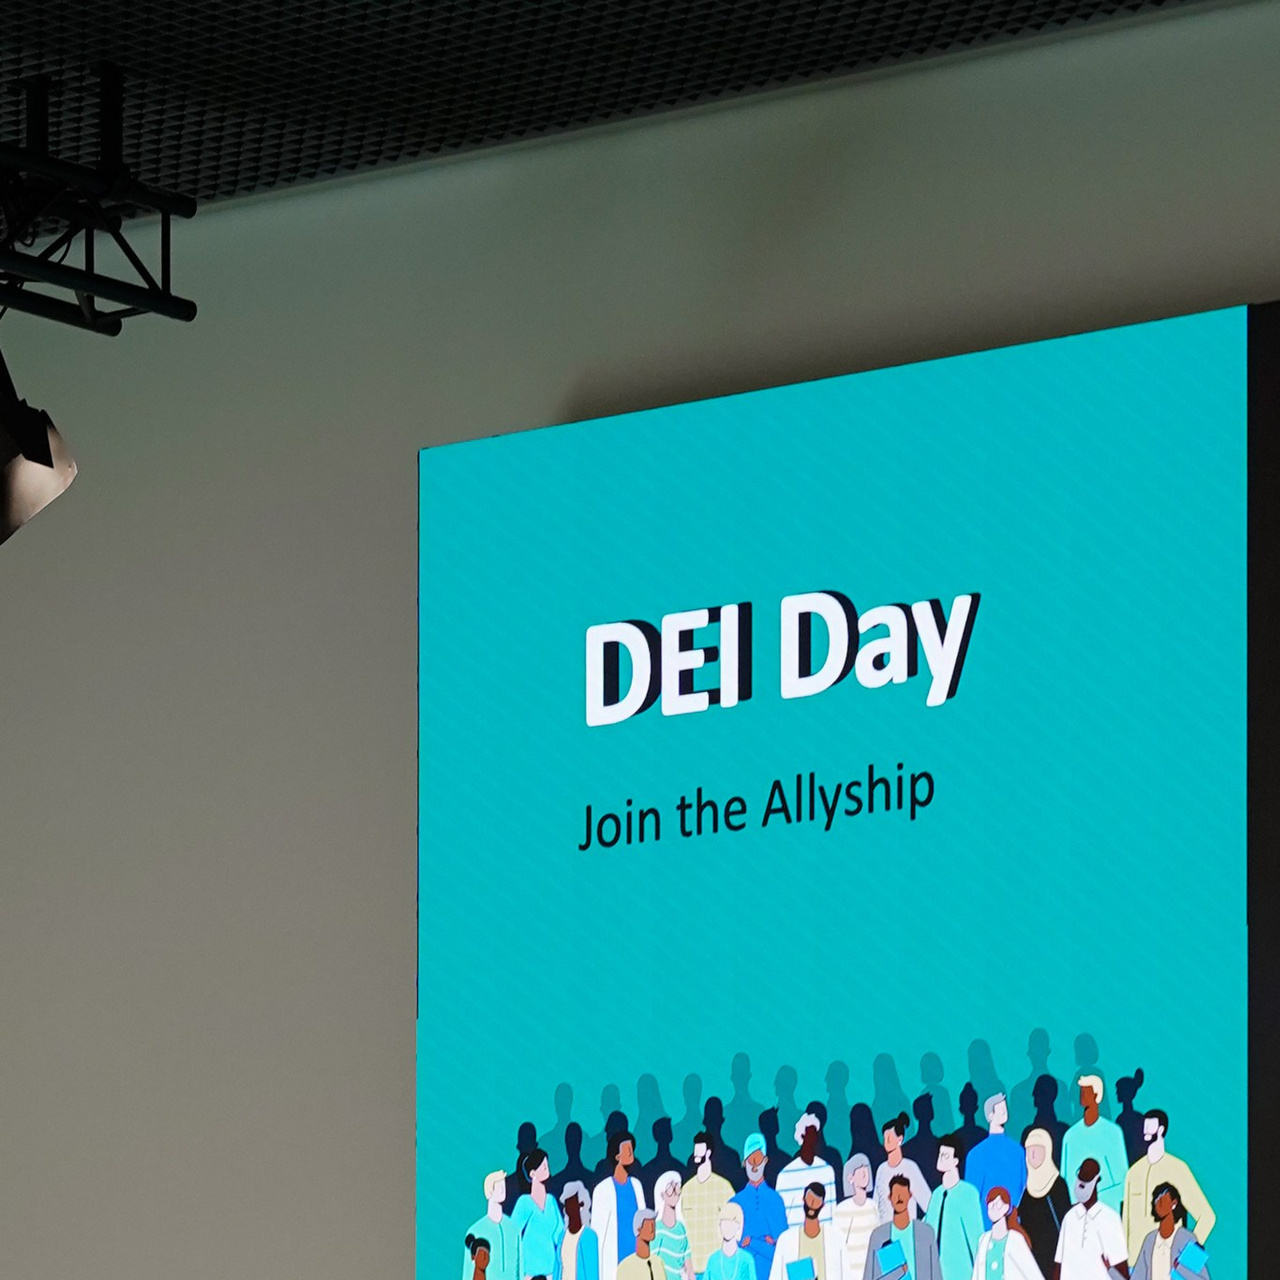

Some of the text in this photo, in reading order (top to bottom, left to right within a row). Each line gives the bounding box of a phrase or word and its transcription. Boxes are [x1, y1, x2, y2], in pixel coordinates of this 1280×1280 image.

[586, 591, 982, 727] DEI Day
[578, 763, 935, 852] Join the Allyship
